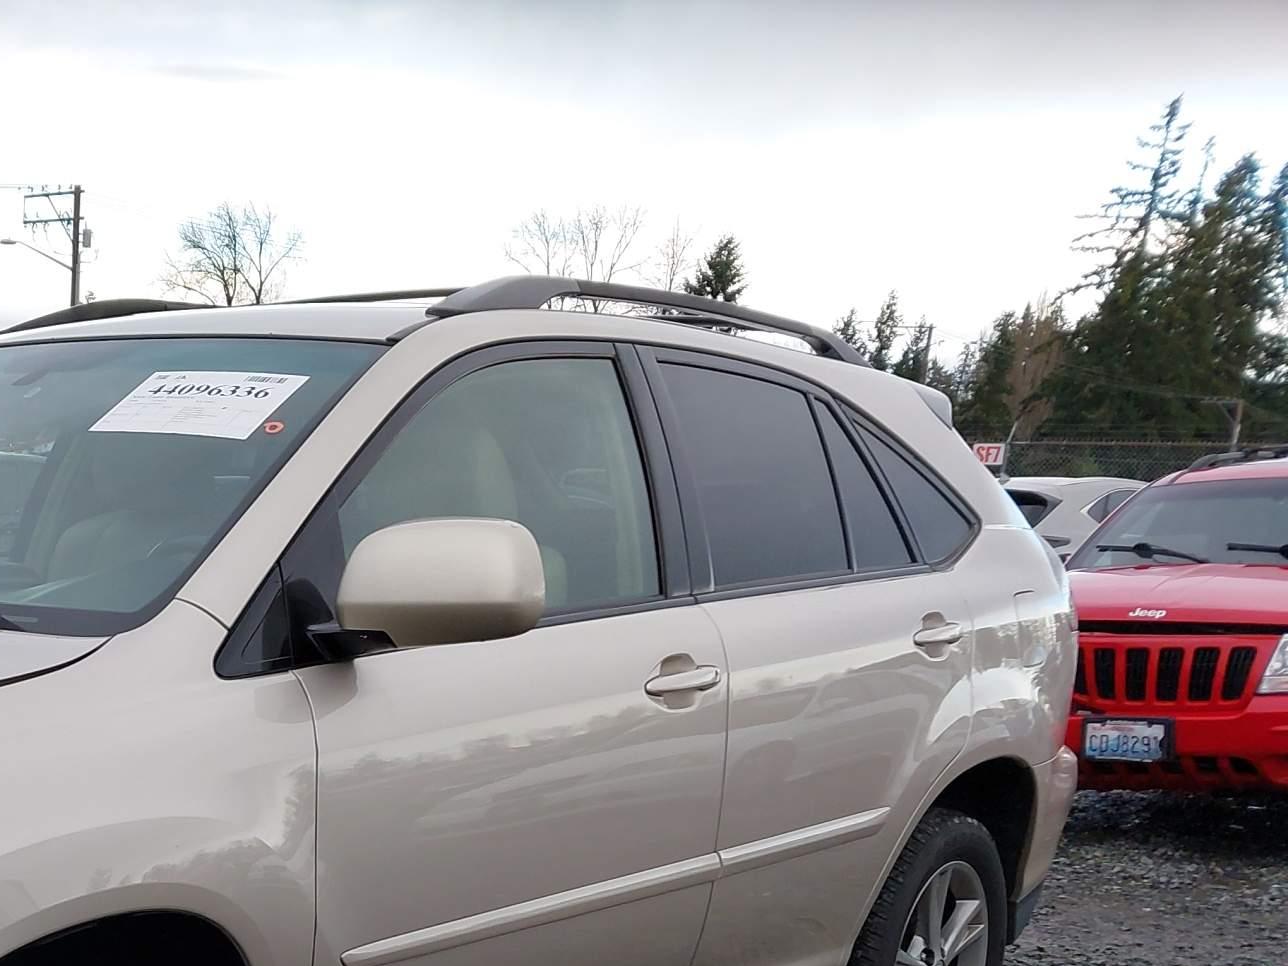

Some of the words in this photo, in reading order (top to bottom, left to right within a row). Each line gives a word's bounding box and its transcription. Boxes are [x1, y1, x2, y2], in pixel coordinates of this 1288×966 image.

[149, 383, 271, 399] 44096336
[976, 446, 1001, 463] SF7
[1128, 607, 1167, 619] Jeep
